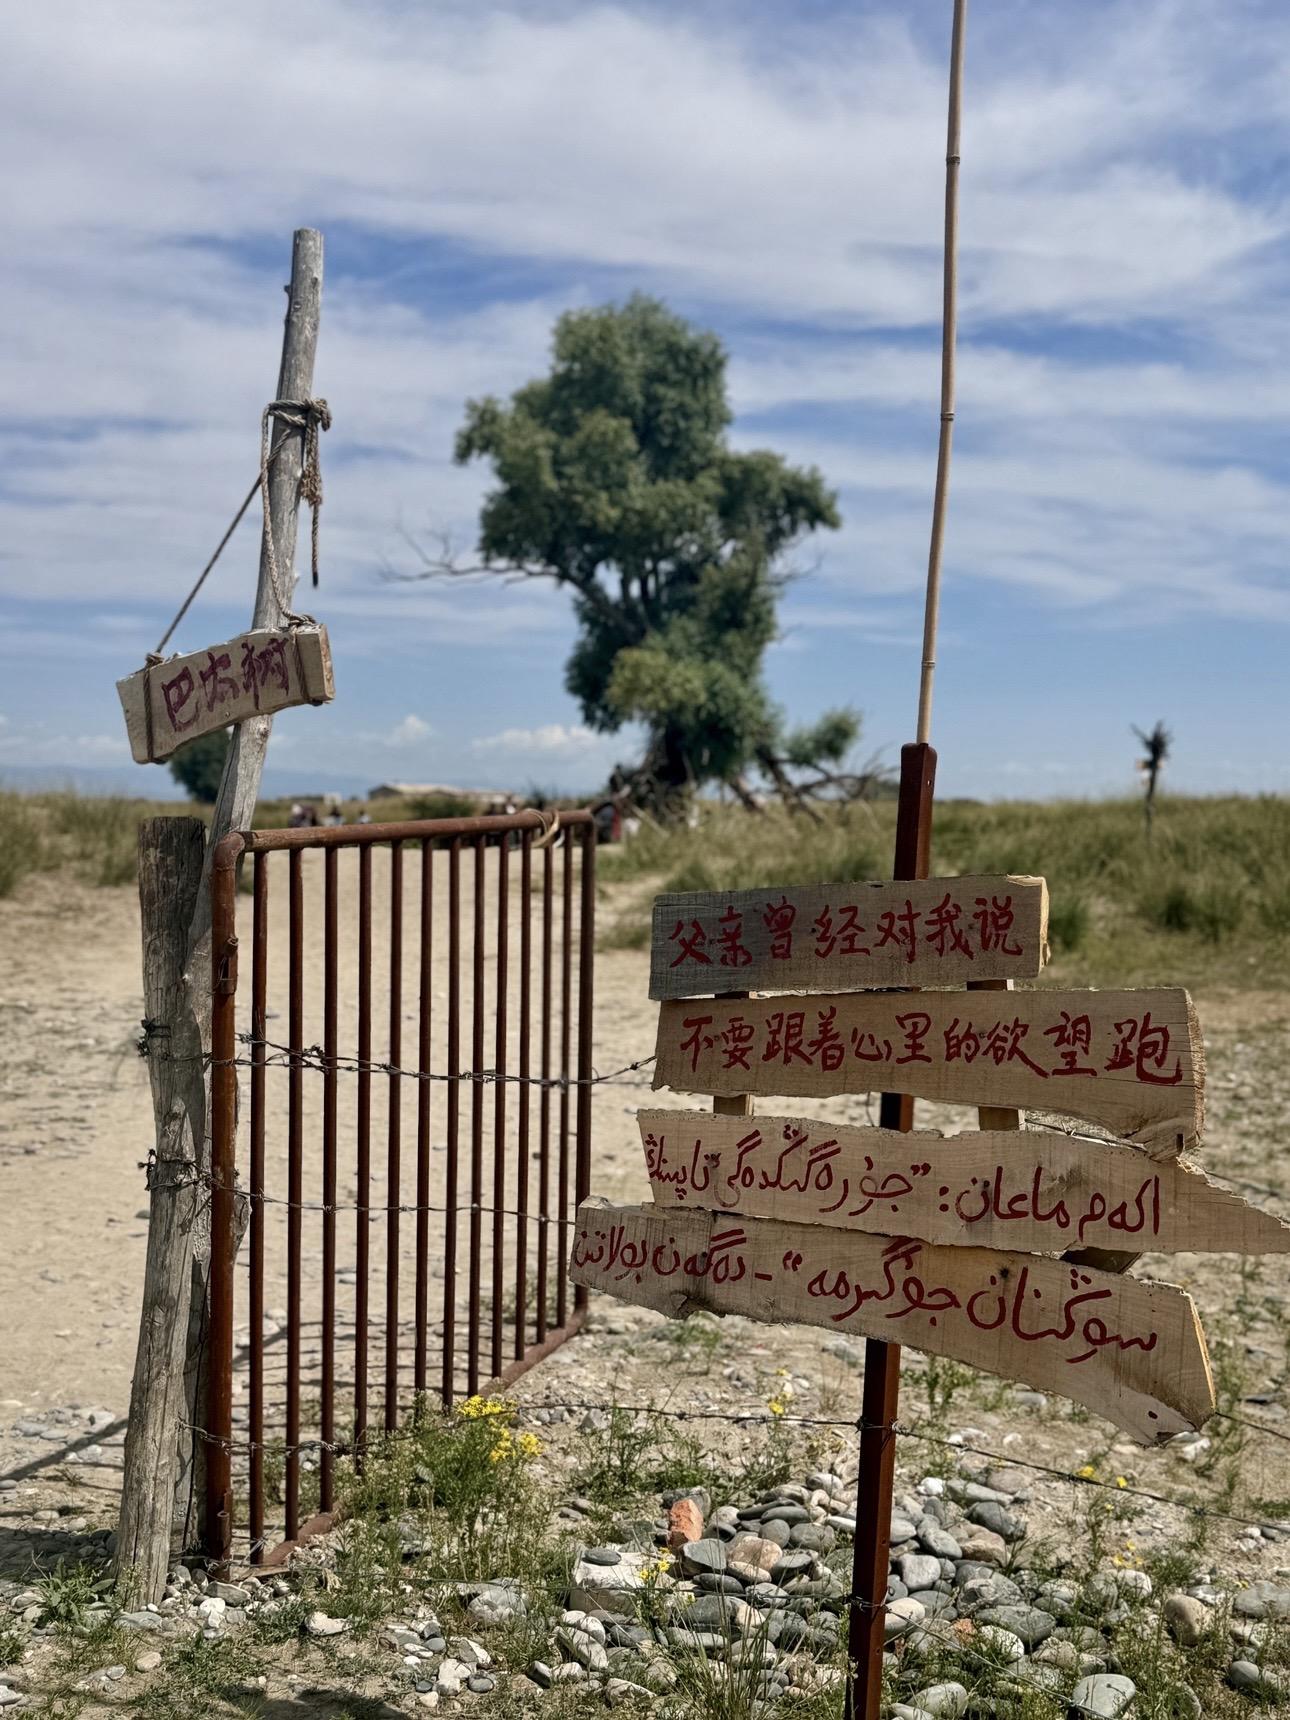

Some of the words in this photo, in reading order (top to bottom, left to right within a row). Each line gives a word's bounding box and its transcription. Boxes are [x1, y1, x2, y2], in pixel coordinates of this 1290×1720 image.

[669, 893, 1023, 968] 父亲曾经对我说
[680, 1006, 1184, 1085] 不要跟着心里的欲望跑
